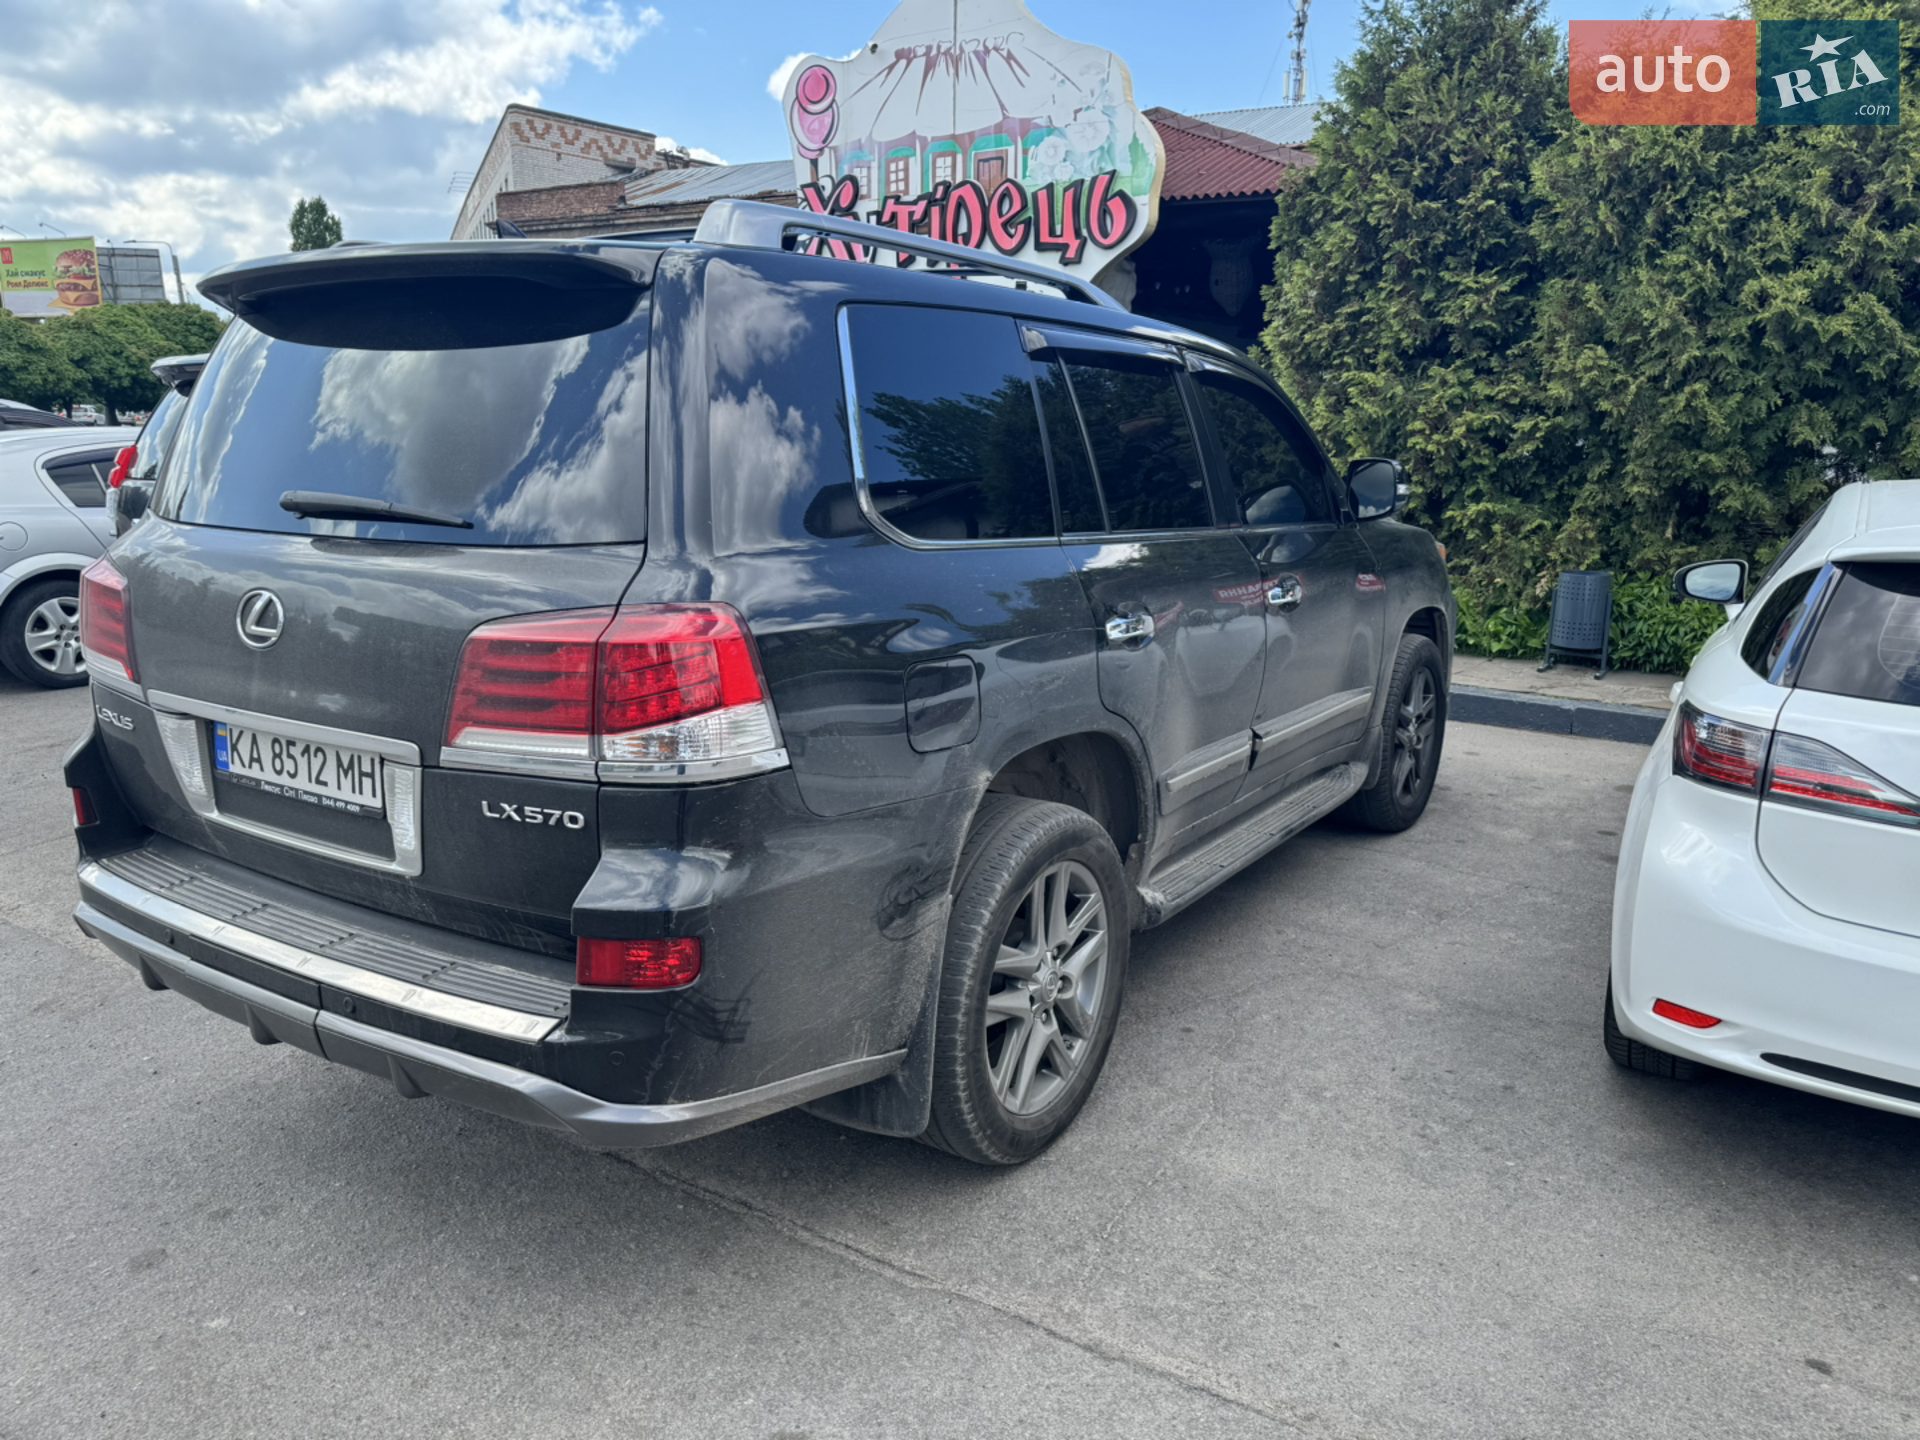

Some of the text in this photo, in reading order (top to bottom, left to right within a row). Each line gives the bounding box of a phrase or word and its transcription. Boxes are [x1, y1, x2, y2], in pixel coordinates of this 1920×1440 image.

[95, 704, 134, 730] LEXUS
[229, 727, 377, 799] KA 8512 MH
